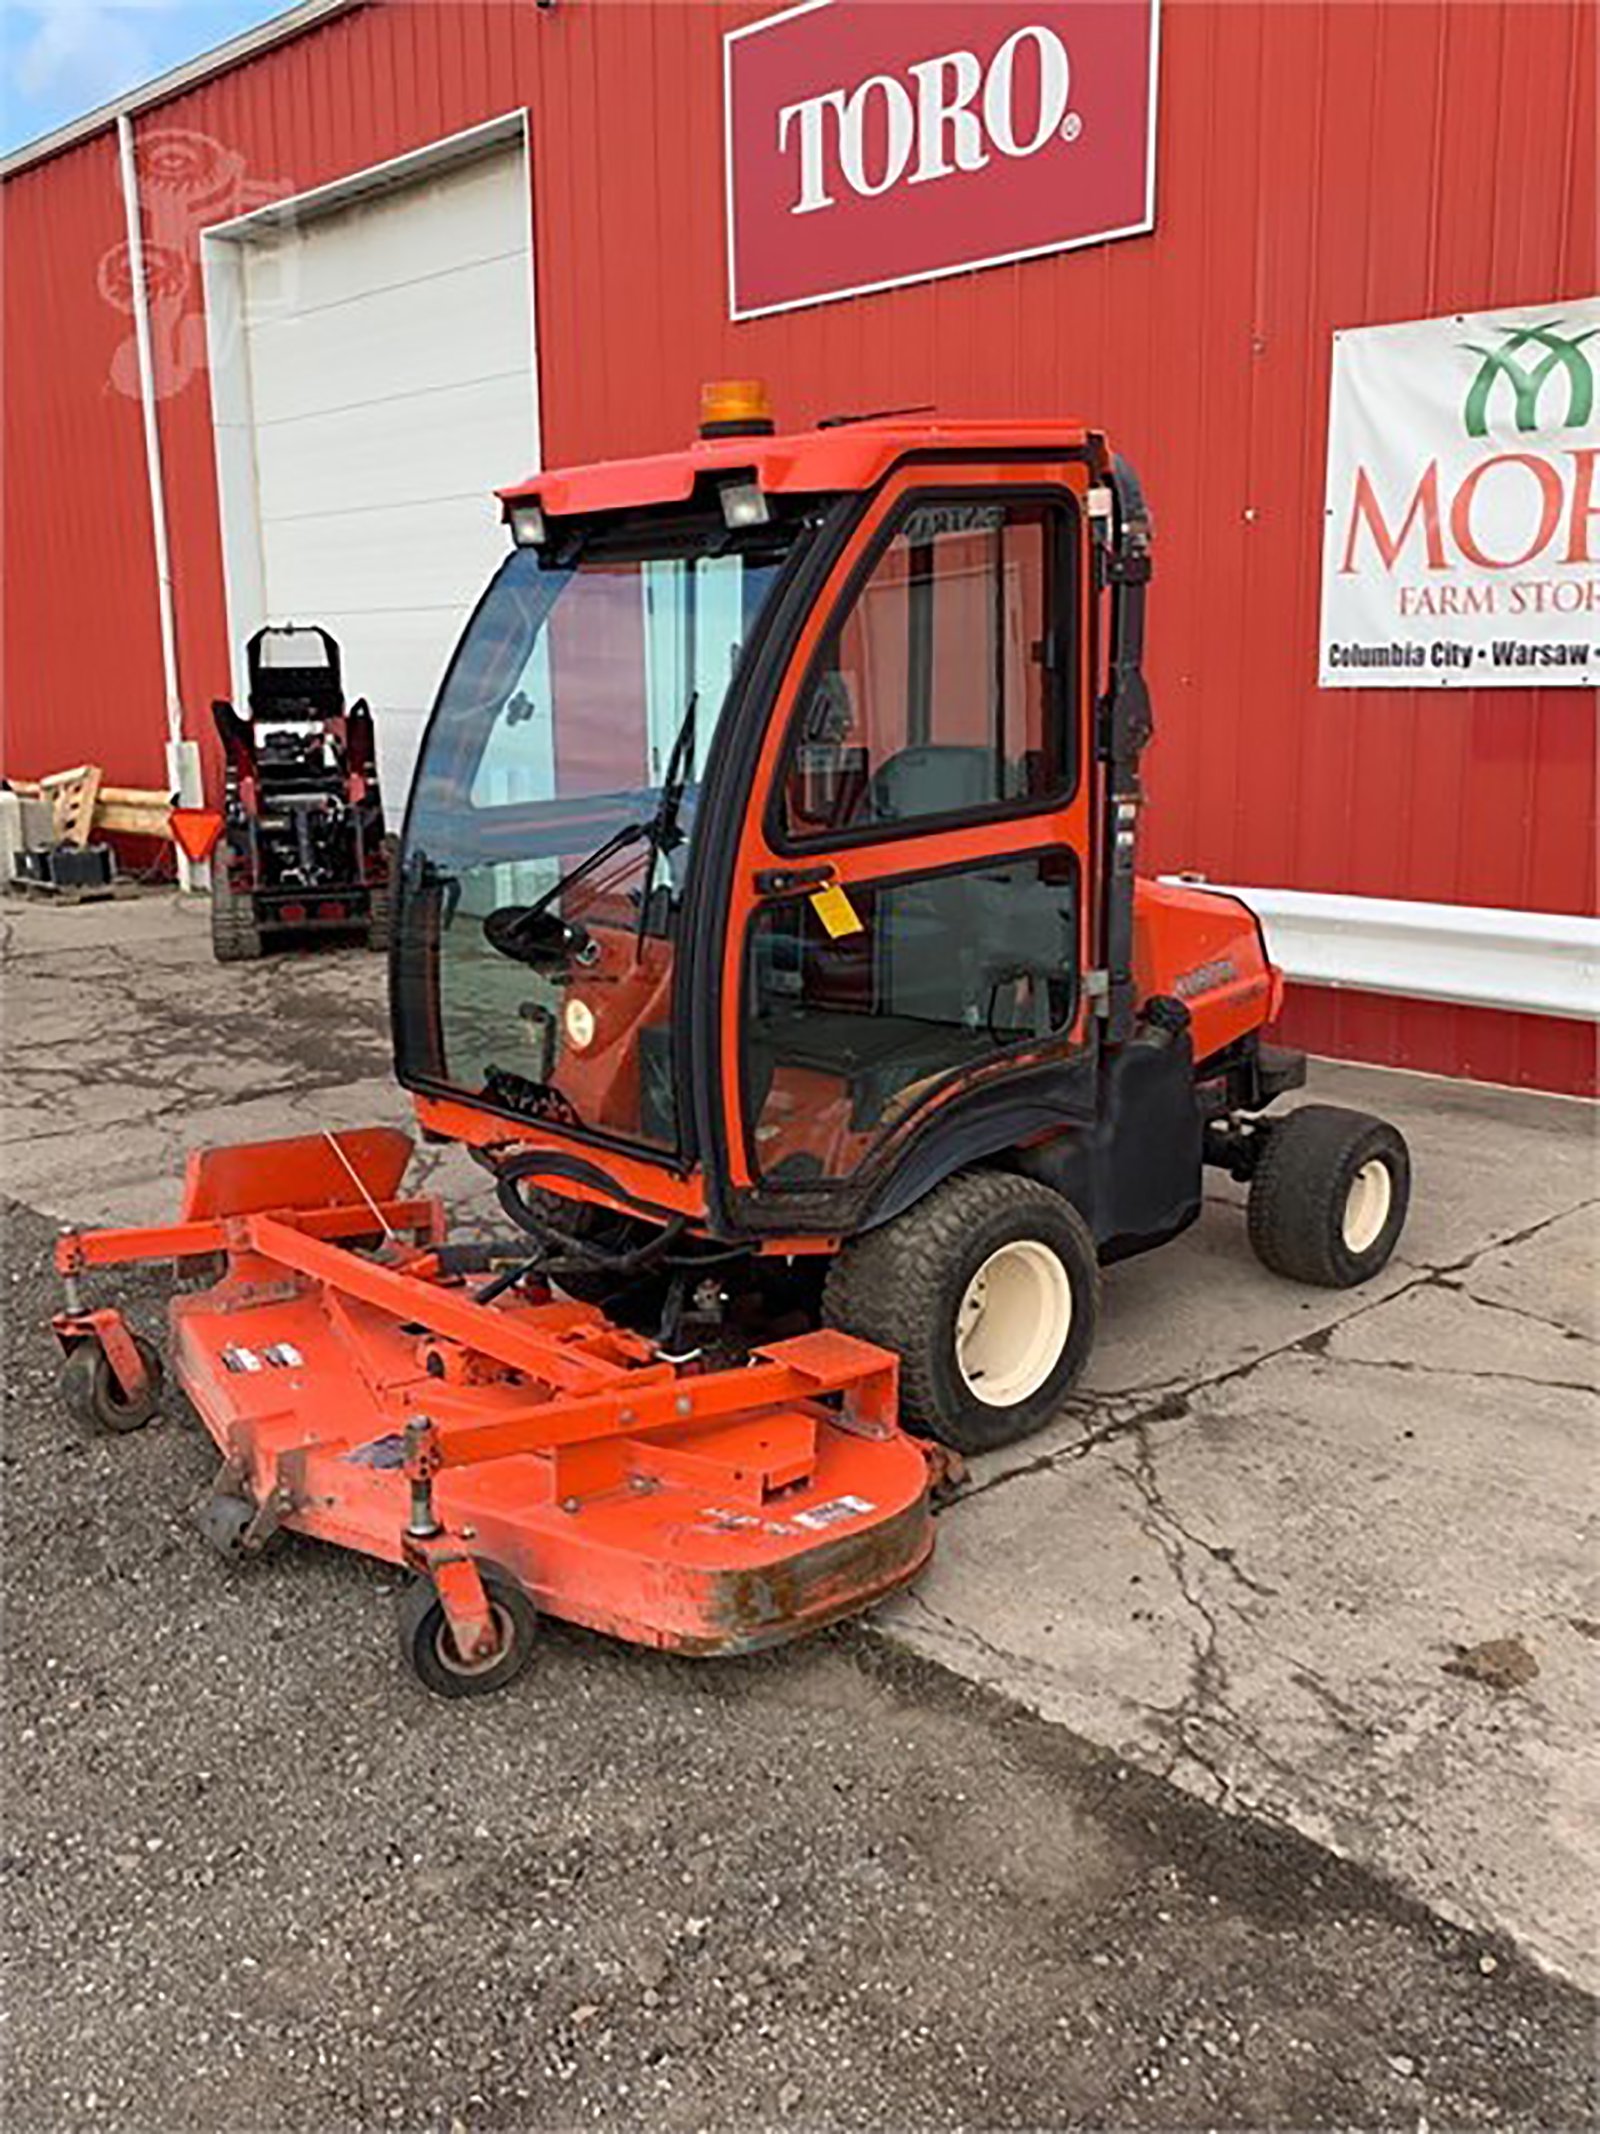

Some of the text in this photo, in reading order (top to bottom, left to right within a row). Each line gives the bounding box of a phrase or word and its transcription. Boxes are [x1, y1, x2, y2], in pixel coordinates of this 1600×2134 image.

[778, 25, 1070, 214] TORO
[1400, 584, 1495, 616] FARM
[1328, 640, 1590, 668] Columbia City Warsaw
